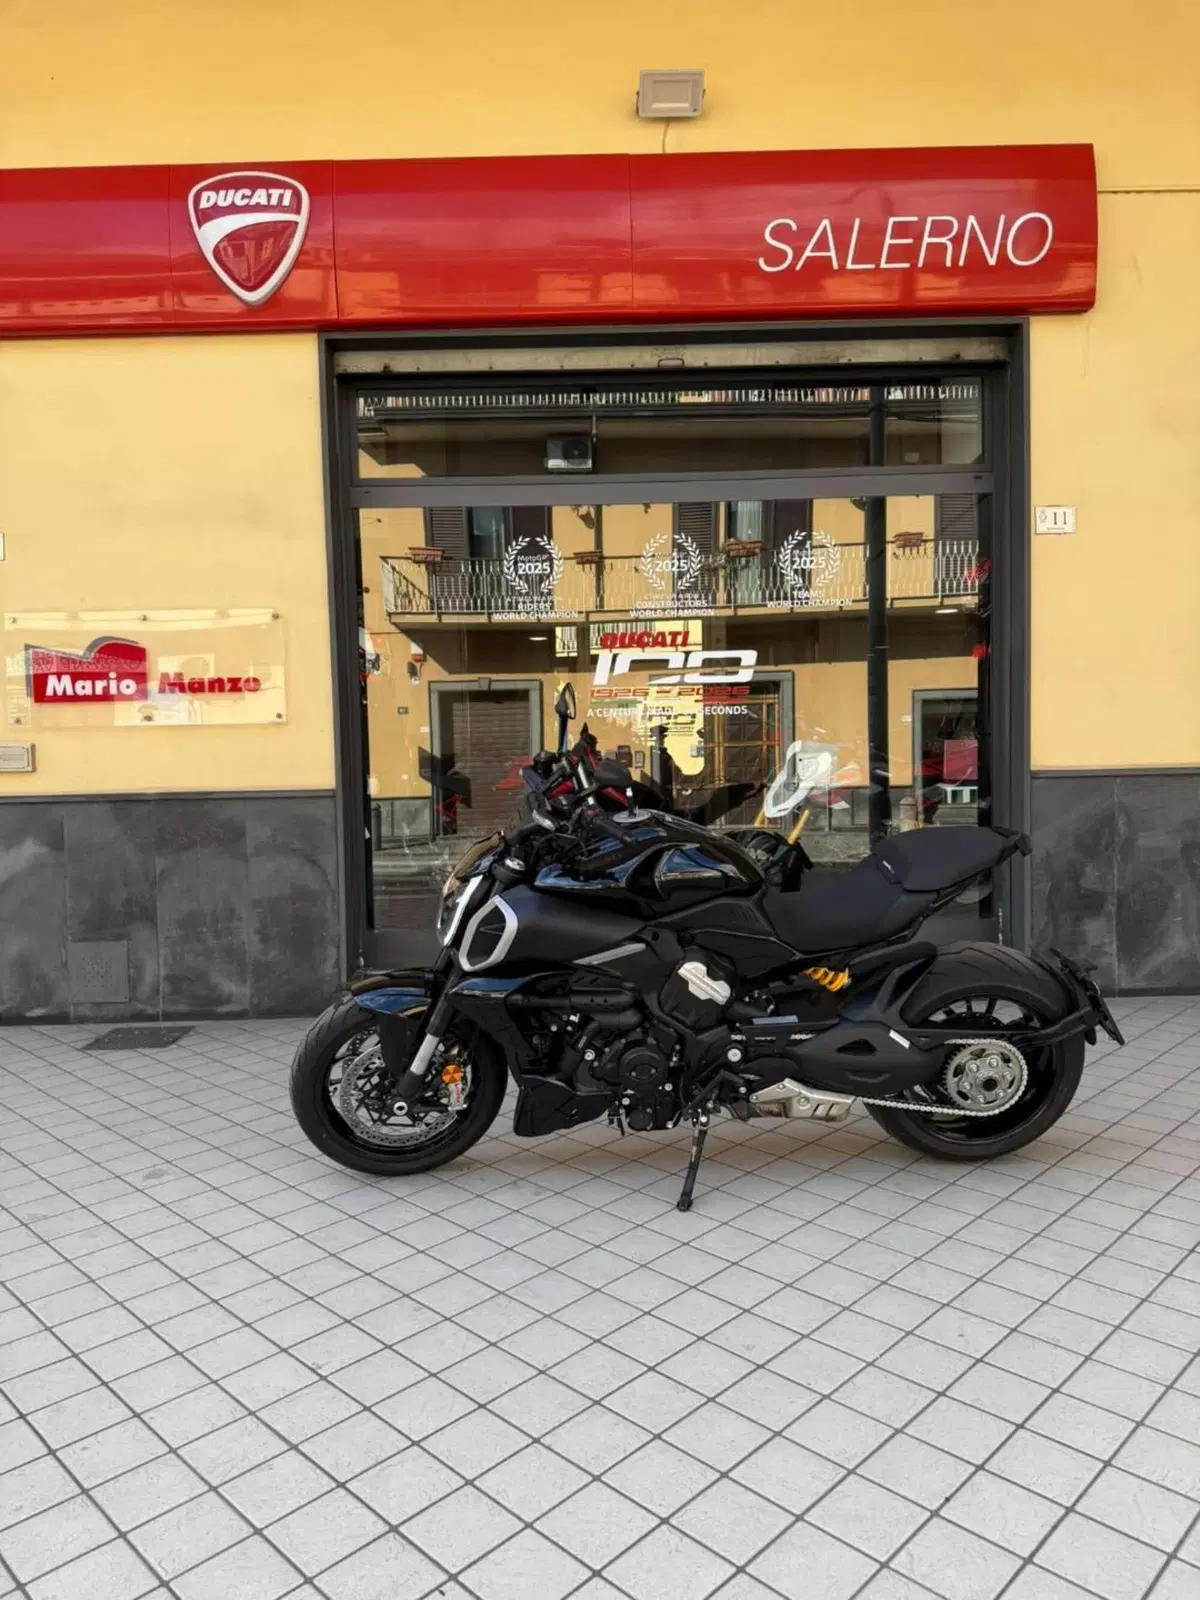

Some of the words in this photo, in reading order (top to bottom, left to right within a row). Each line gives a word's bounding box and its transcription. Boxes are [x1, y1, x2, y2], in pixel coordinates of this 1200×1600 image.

[199, 188, 293, 209] DUCATI
[758, 211, 1054, 273] SALERNO
[1053, 511, 1068, 526] 11
[517, 561, 551, 575] 2025
[655, 559, 688, 573] 2025
[792, 556, 826, 570] 2025
[767, 600, 801, 609] WORLD
[803, 597, 853, 608] CHAMPION
[493, 611, 527, 620] WORLD
[529, 609, 579, 619] CHAMPION
[629, 609, 663, 619] WORLD
[665, 607, 715, 618] CHAMPION
[600, 630, 690, 649] DUCATI
[593, 649, 758, 686] 100
[45, 671, 137, 697] Mario
[158, 672, 261, 694] Manzo
[590, 686, 649, 699] 1926
[698, 705, 748, 716] SECONDS
